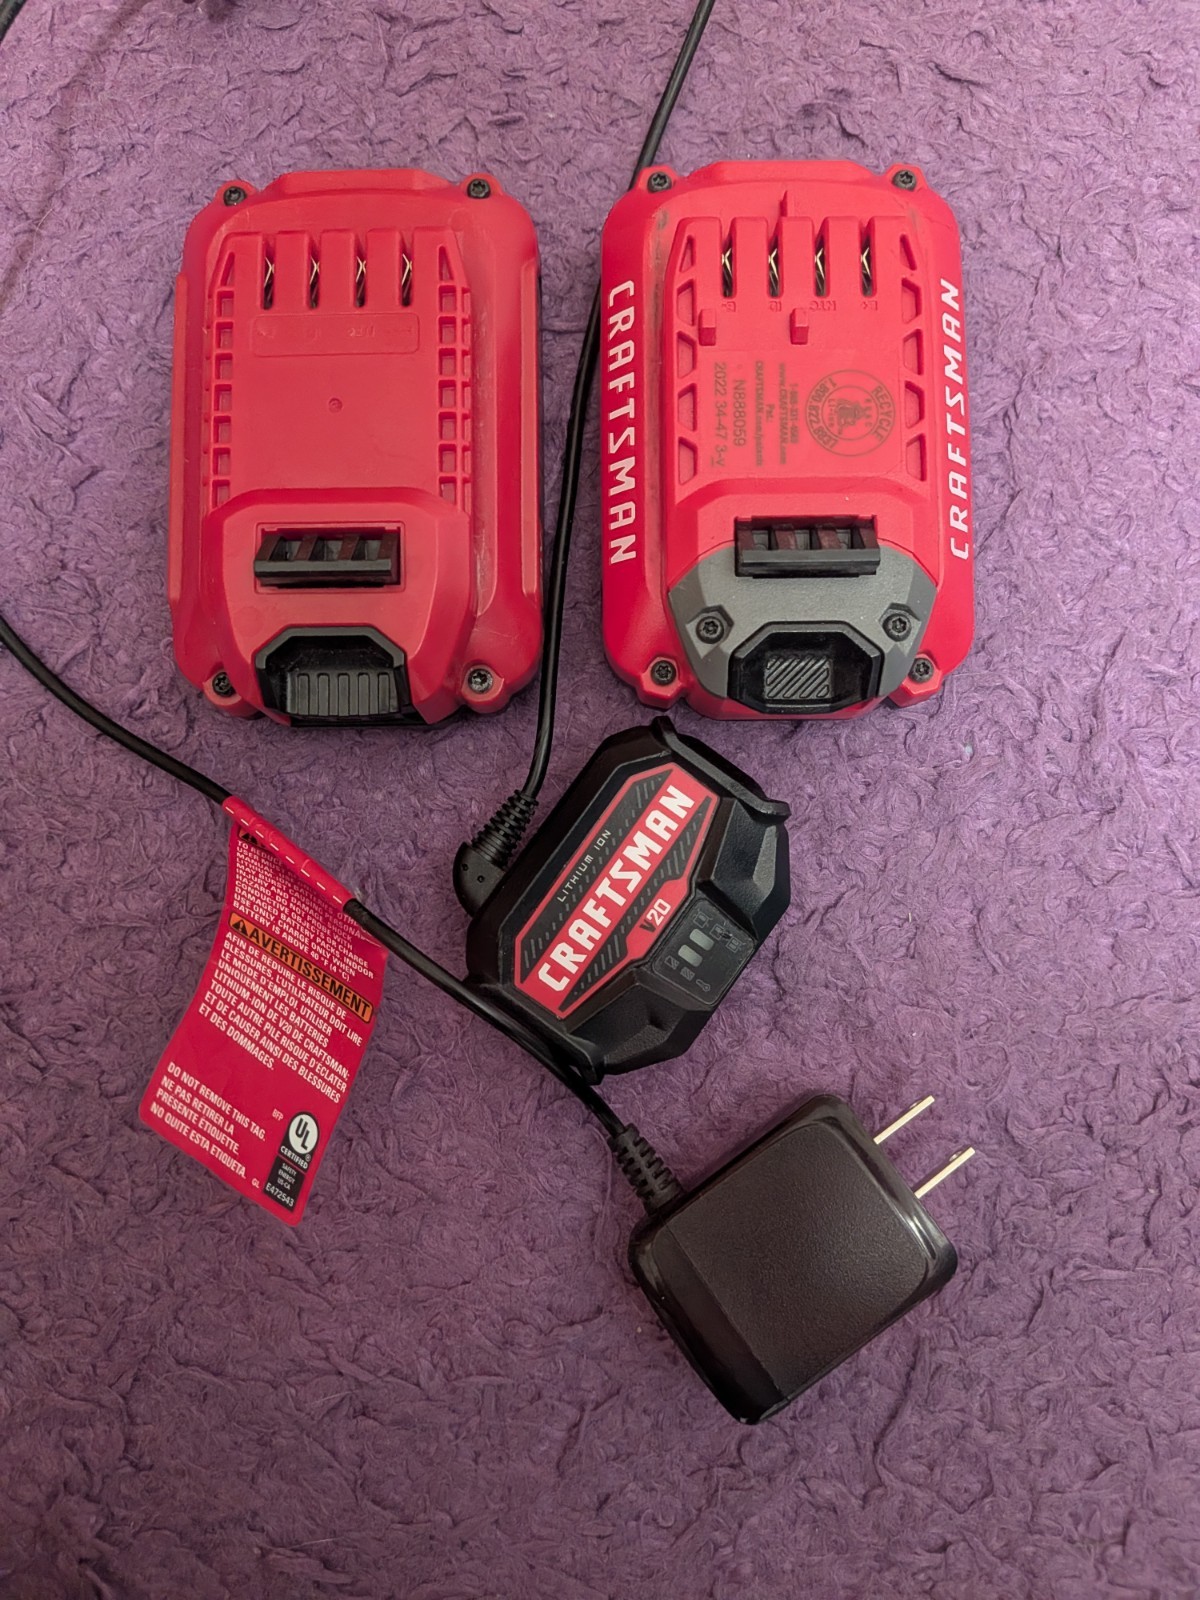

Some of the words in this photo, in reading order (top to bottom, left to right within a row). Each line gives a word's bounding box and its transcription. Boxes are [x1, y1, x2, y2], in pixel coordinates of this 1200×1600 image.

[714, 362, 727, 396] 2022
[733, 379, 746, 447] N888059
[870, 385, 893, 443] RECYCLE
[608, 280, 637, 563] CRAFTSMAN
[715, 401, 727, 440] 34-47
[939, 279, 969, 560] CRAFTSMAN
[236, 846, 258, 860] USER
[238, 840, 248, 849] TO
[556, 853, 593, 902] LITHIUM
[593, 828, 611, 850] ION
[236, 863, 255, 875] MAY
[258, 873, 286, 890] BURST
[288, 888, 323, 914] CAUSING
[236, 868, 268, 887] INJURY
[270, 886, 288, 899] AND
[327, 921, 352, 942] SHOCK
[236, 874, 273, 898] HAZARD.
[275, 895, 287, 905] DO
[289, 902, 305, 917] NOT
[306, 915, 332, 936] PROBE
[333, 932, 353, 950] WITH
[236, 880, 290, 915] CONDUCTIVE
[290, 912, 325, 939] OBJECTS
[326, 936, 336, 947] OR
[338, 944, 367, 968] CHARGE
[537, 784, 695, 991] CRAFTSMAN
[638, 897, 671, 936] V20
[232, 900, 270, 927] BATTERY
[272, 925, 280, 934] IS
[281, 932, 309, 953] ABOVE
[310, 951, 319, 960] 40
[234, 893, 251, 907] USE
[253, 904, 275, 922] ONLY.
[277, 919, 309, 945] CHARGE
[310, 942, 330, 958] ONLY
[332, 956, 356, 976] WHEN
[235, 886, 278, 915] DAMAGED
[281, 912, 314, 939] BATTERY
[316, 936, 341, 959] PACKS.
[344, 956, 373, 979] INDOOR
[213, 969, 267, 1013] LITHIUM-ION
[266, 1008, 278, 1023] DE
[278, 1018, 292, 1034] V20
[292, 1028, 304, 1043] DE
[217, 959, 275, 1004] UNIQUEMENT
[274, 999, 289, 1016] LES
[288, 1011, 329, 1047] BATTERIES
[220, 949, 231, 961] LE
[232, 957, 258, 980] MODE
[259, 975, 298, 1010] D'EMPLOI.
[299, 1005, 333, 1036] UTILISER
[225, 931, 247, 949] AFIN
[248, 945, 260, 958] DE
[296, 978, 307, 990] LE
[307, 985, 336, 1011] RISQUE
[335, 1006, 347, 1020] DE
[249, 927, 370, 1017] AVERTISSEMENT
[198, 1002, 211, 1017] ET
[209, 1011, 227, 1031] DES
[226, 1025, 275, 1070] DOMMAGES.
[204, 990, 217, 1004] ET
[216, 999, 229, 1015] DE
[228, 1009, 260, 1040] CAUSER
[259, 1036, 283, 1058] AINSI
[282, 1052, 299, 1070] DES
[298, 1065, 340, 1103] BLESSURES
[209, 979, 238, 1006] TOUTE
[236, 1001, 264, 1027] AUTRE
[263, 1022, 281, 1041] PILE
[280, 1035, 309, 1063] RISQUE
[308, 1057, 347, 1092] D'ÉCLATER
[275, 974, 329, 1019] L'UTILISATEUR
[328, 1014, 347, 1033] DOIT
[346, 1028, 362, 1046] LIRE
[160, 1075, 174, 1091] NE
[174, 1084, 192, 1103] PAS
[191, 1097, 225, 1127] RETIRER
[223, 1120, 235, 1135] LA
[167, 1061, 181, 1077] DO
[180, 1071, 200, 1090] NOT
[198, 1084, 232, 1115] REMOVE
[231, 1108, 250, 1128] THIS
[248, 1121, 266, 1141] TAG.
[296, 1118, 309, 1150] UL
[149, 1101, 164, 1118] NO
[163, 1112, 190, 1136] QUITE
[188, 1130, 210, 1151] ESTA
[209, 1144, 246, 1179] ETIQUETA.
[280, 1145, 308, 1169] CERTIFIED
[265, 1182, 294, 1207] E472543
